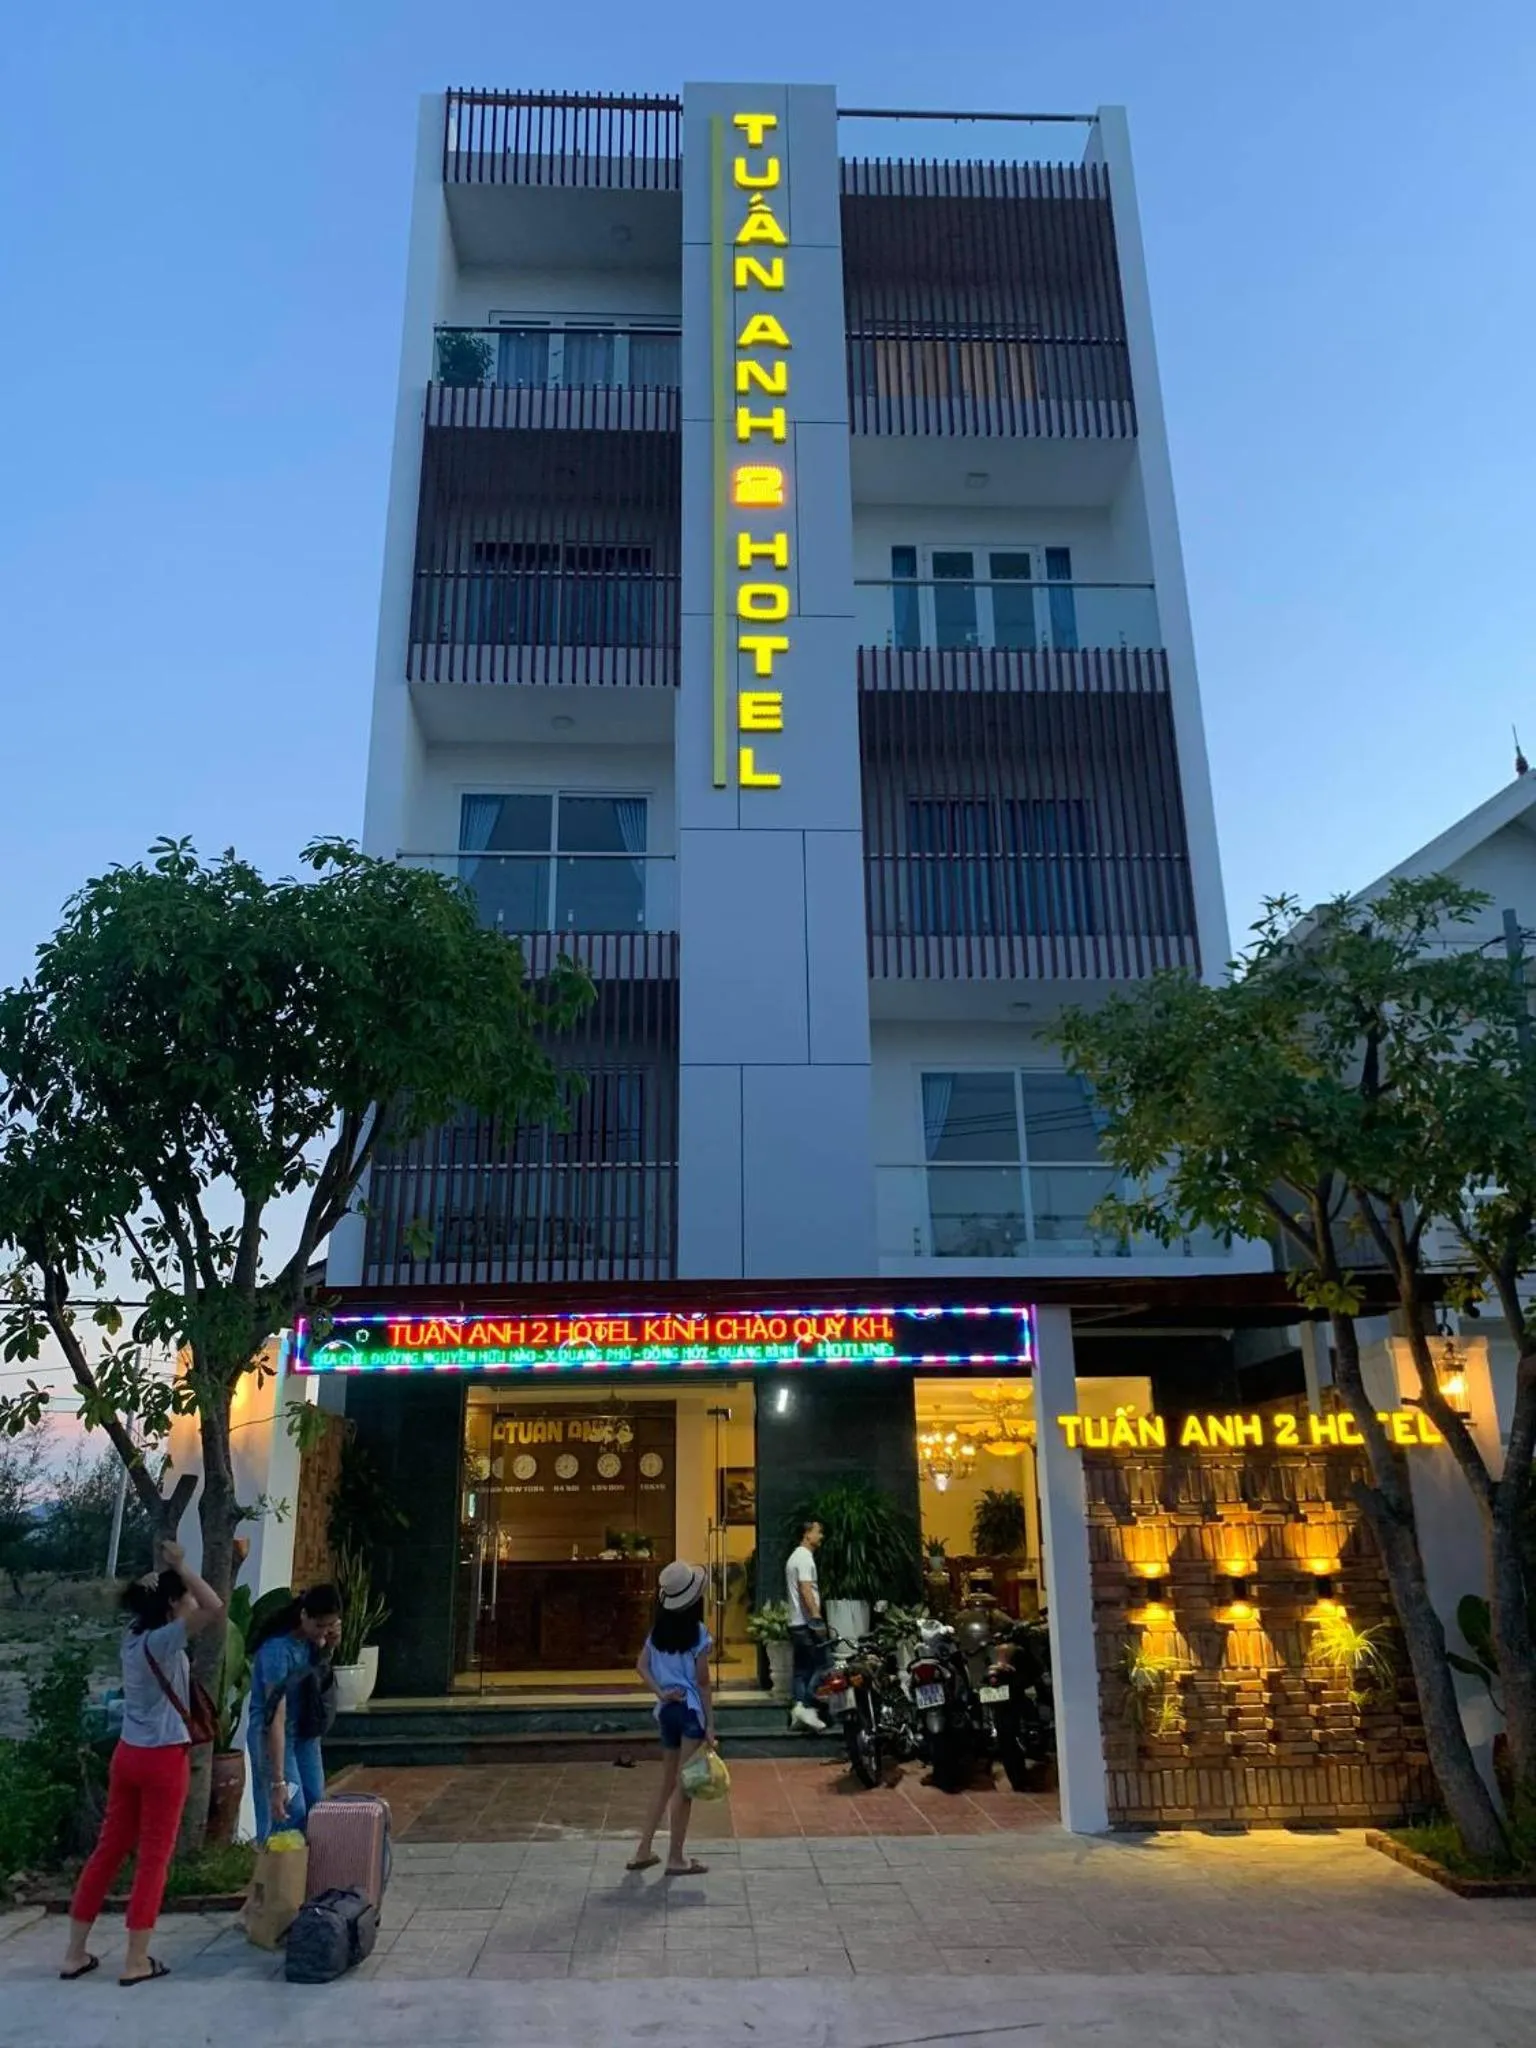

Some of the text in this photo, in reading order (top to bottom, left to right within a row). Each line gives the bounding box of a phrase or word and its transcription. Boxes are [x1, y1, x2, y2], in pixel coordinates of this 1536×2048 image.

[733, 113, 792, 789] TUẤN ANH 2 HOTEL
[468, 1321, 525, 1345] ANH
[531, 1321, 549, 1344] 2
[555, 1319, 638, 1343] HOTEL
[645, 1313, 710, 1341] KÍNH
[715, 1314, 787, 1341] CHÀO
[853, 1316, 894, 1340] KH
[1057, 1405, 1444, 1448] TUẤN ANH 2 HOEL
